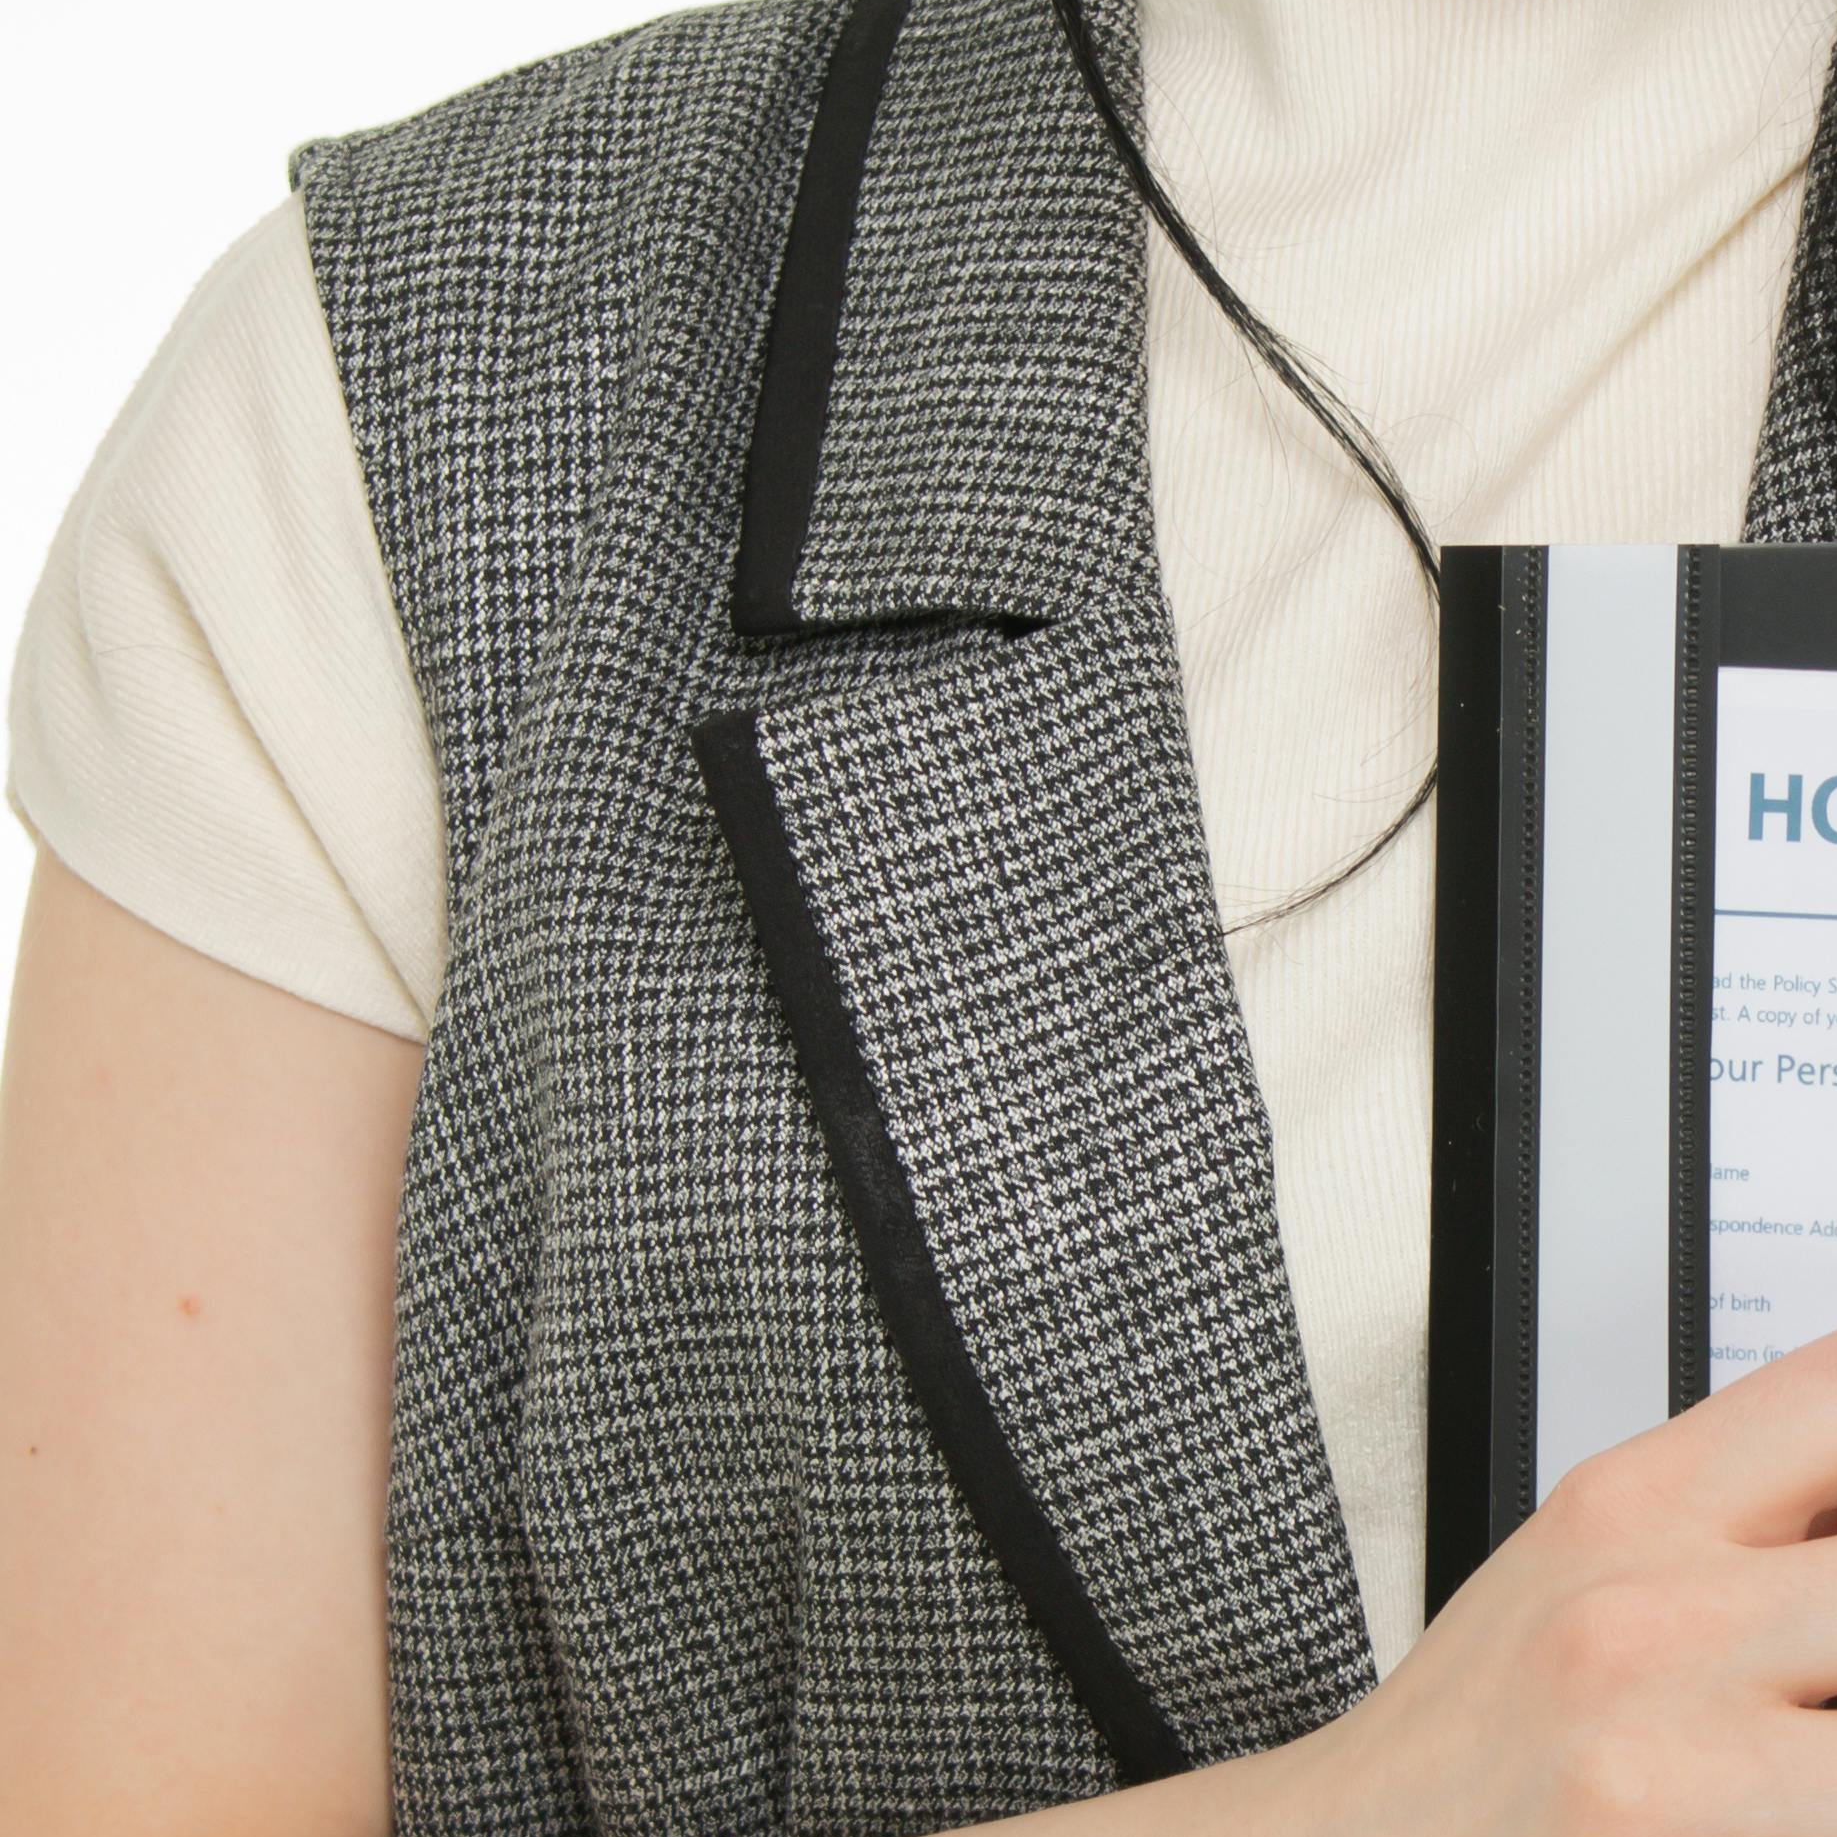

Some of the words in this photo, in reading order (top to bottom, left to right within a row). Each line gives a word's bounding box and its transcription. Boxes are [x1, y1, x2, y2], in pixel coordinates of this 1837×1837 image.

[1739, 973, 1767, 991] the
[1773, 974, 1822, 998] Policy
[1736, 1004, 1752, 1022] A
[1756, 1010, 1798, 1028] copy
[1802, 1007, 1821, 1026] of
